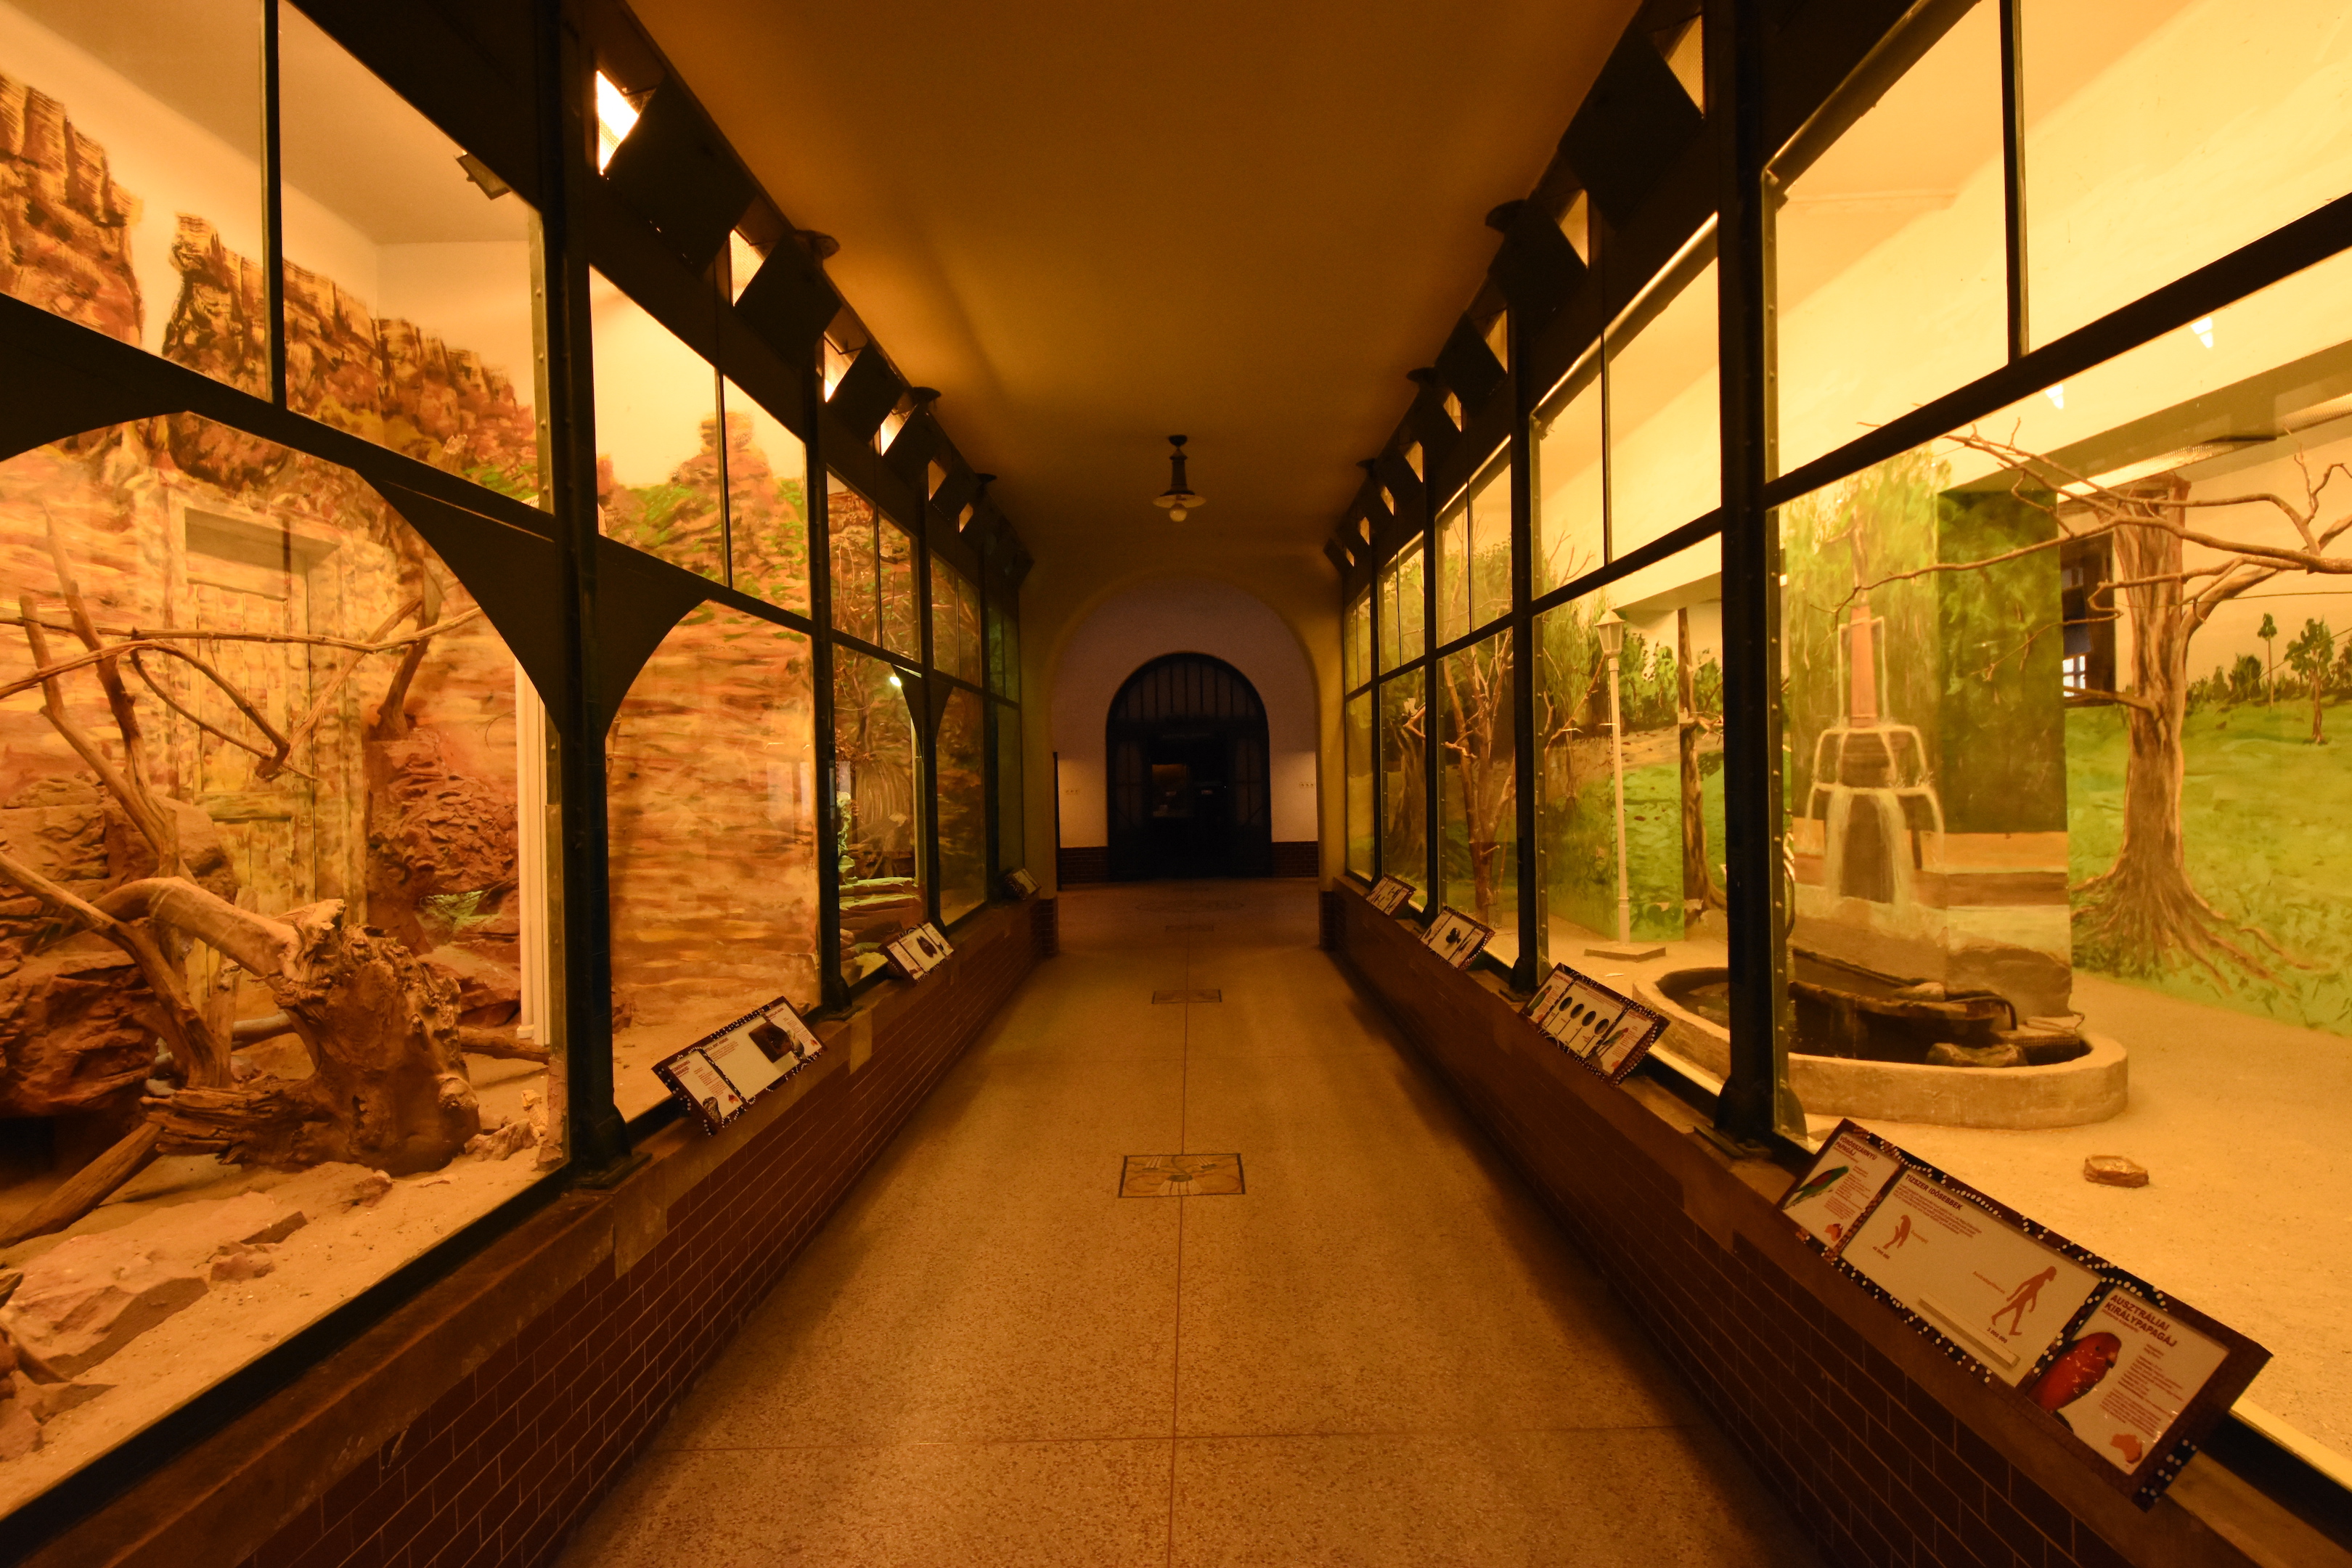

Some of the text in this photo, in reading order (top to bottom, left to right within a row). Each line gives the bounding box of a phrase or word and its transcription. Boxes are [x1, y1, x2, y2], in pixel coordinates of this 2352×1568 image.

[1835, 1142, 1856, 1156] PAPAGÁJ
[1906, 1175, 1962, 1210] TÍZSZER IDŐSEBBEK
[2104, 1302, 2177, 1347] KIRÁLYPAPAGÁJ
[2110, 1295, 2170, 1331] AUSZTRÁLIAI
